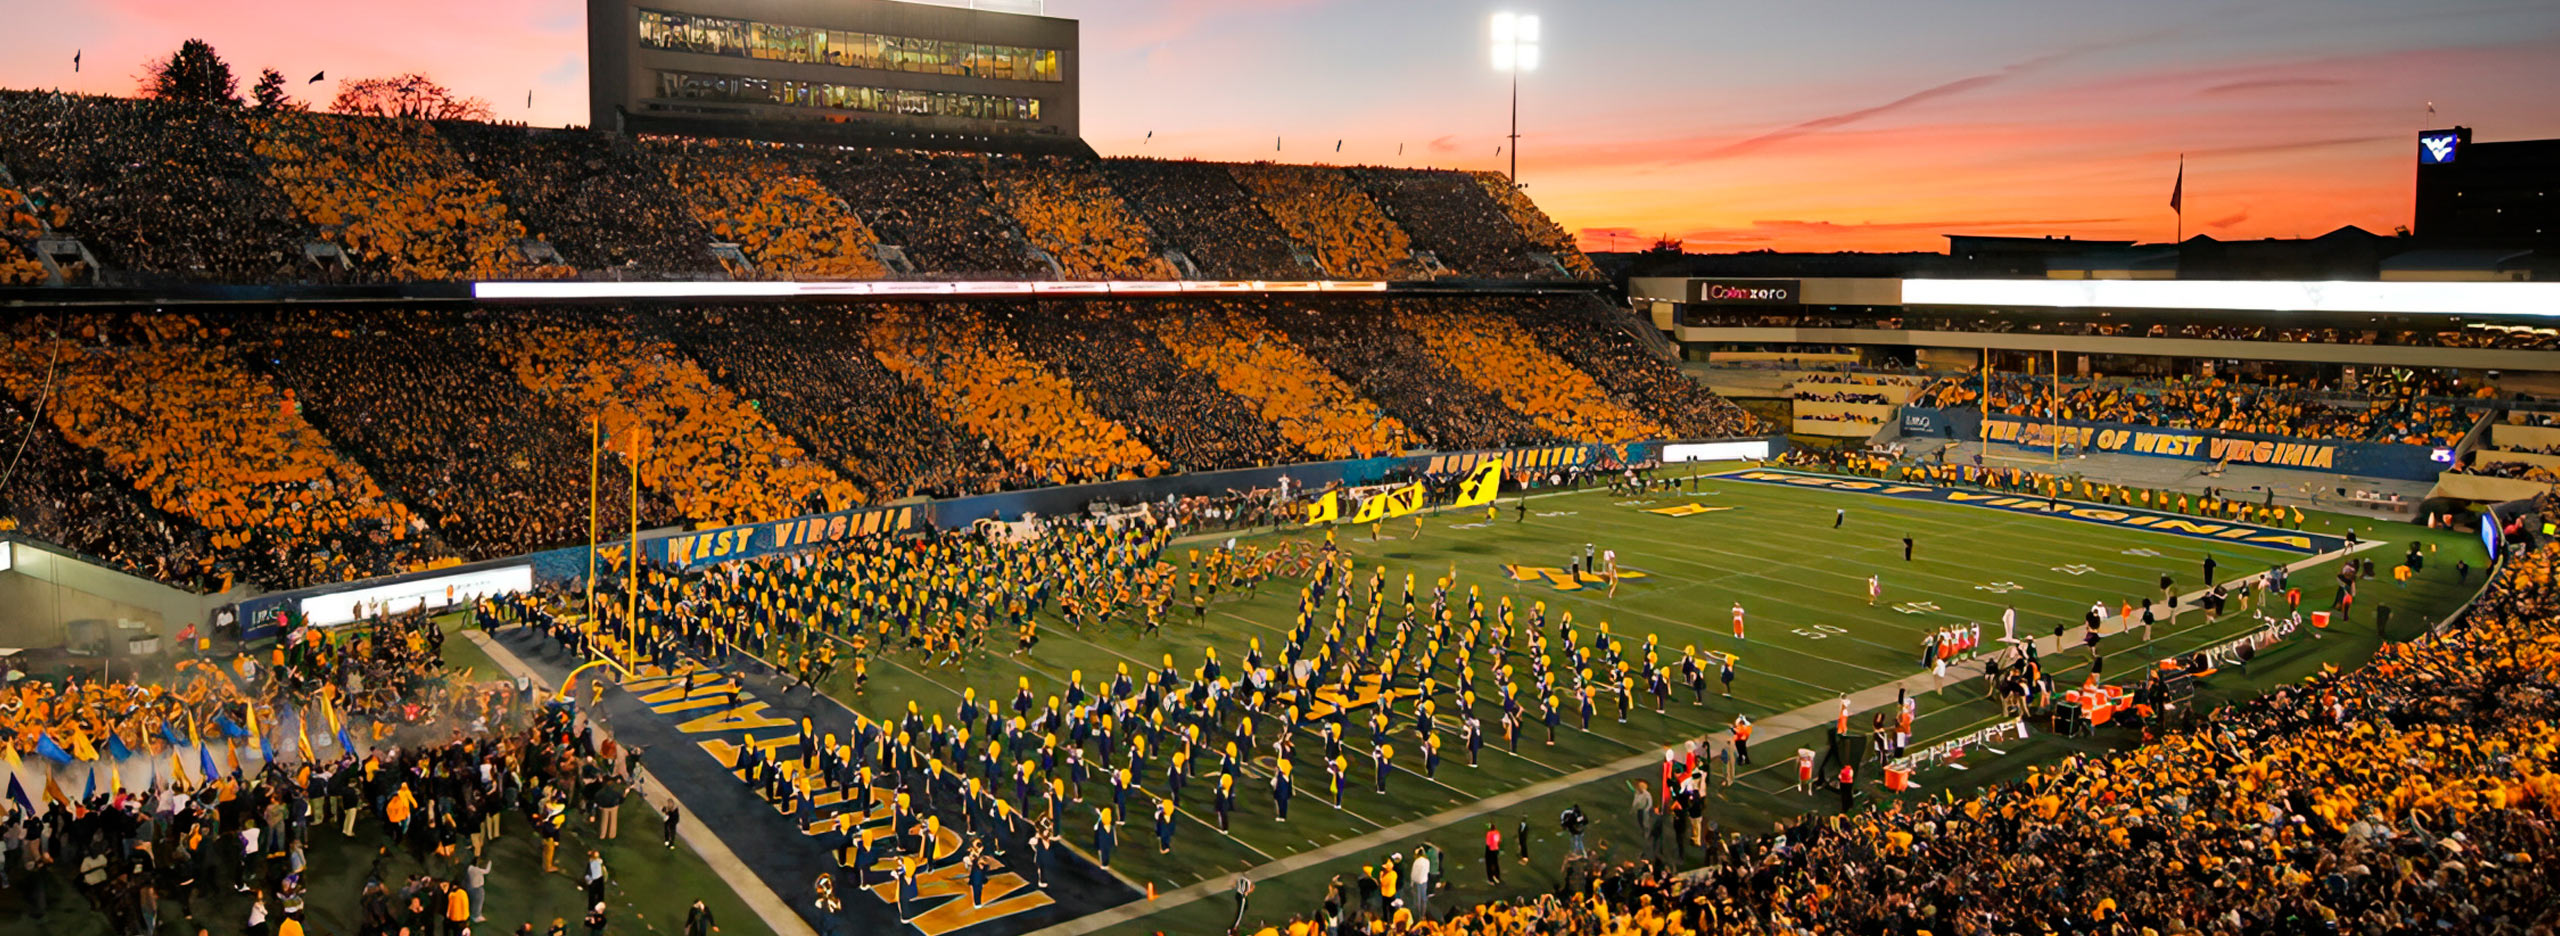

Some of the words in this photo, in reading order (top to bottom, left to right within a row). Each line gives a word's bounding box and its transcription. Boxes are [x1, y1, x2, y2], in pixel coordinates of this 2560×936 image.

[2097, 429, 2131, 450] OF
[2134, 432, 2203, 456] WEST
[2210, 437, 2334, 468] VIRGINIA
[667, 527, 755, 564] WEST
[775, 507, 912, 548] VIRGINIA
